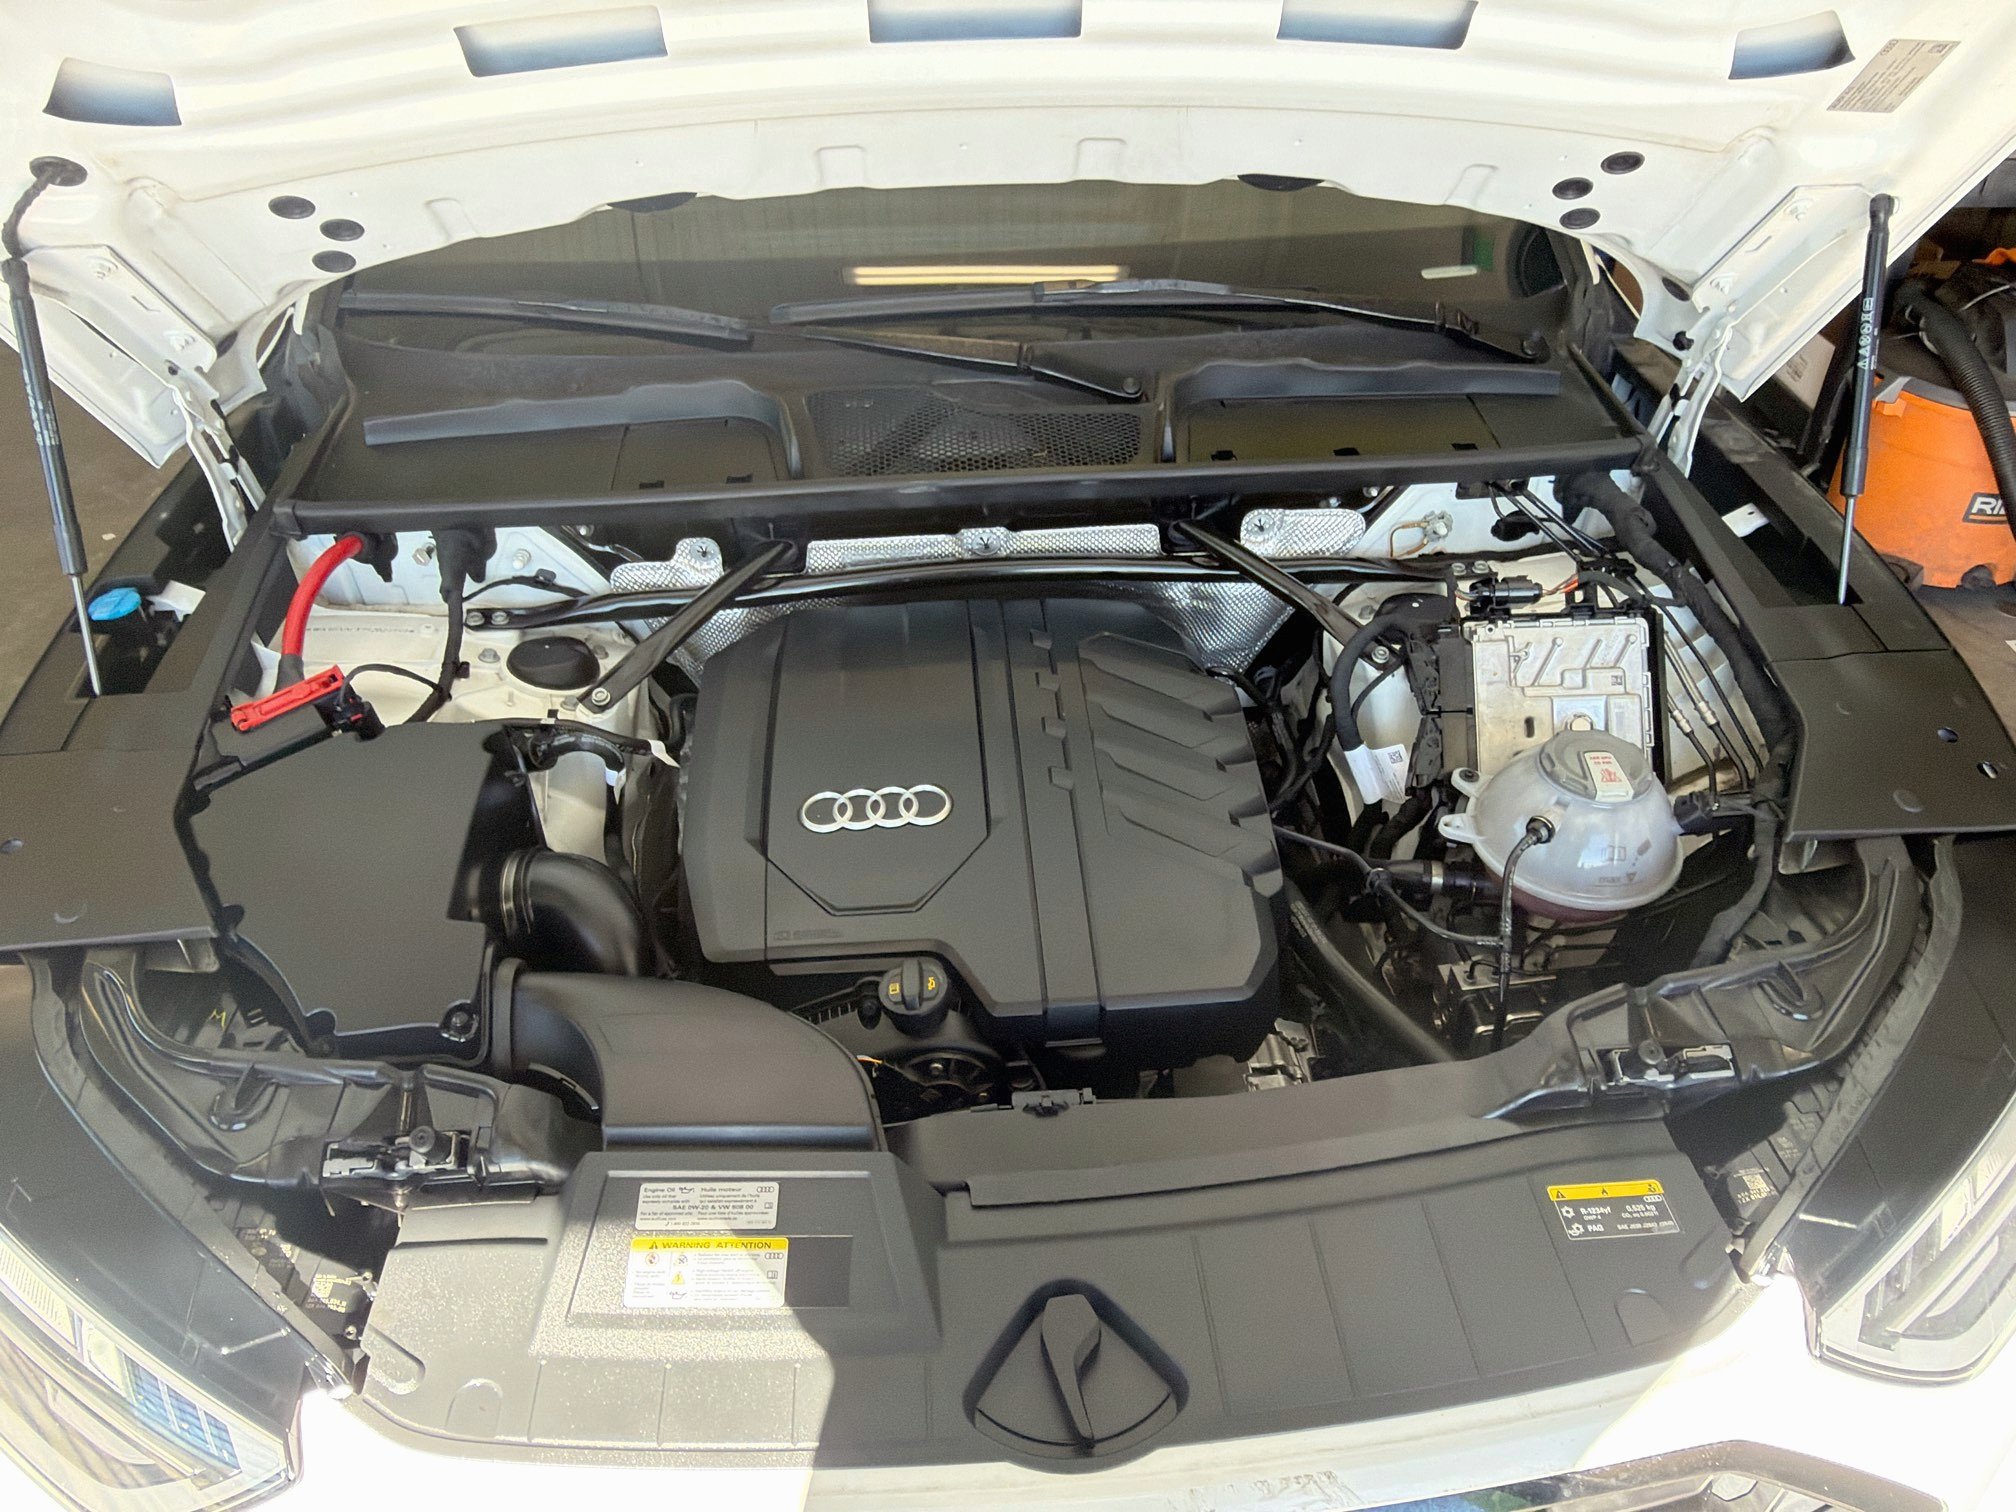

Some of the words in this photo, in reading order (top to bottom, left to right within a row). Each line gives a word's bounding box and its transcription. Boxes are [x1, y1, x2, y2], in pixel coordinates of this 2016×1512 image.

[1580, 1206, 1612, 1215] R-1234yf
[661, 1241, 711, 1249] WARNING
[716, 1241, 772, 1249] ATTENTION
